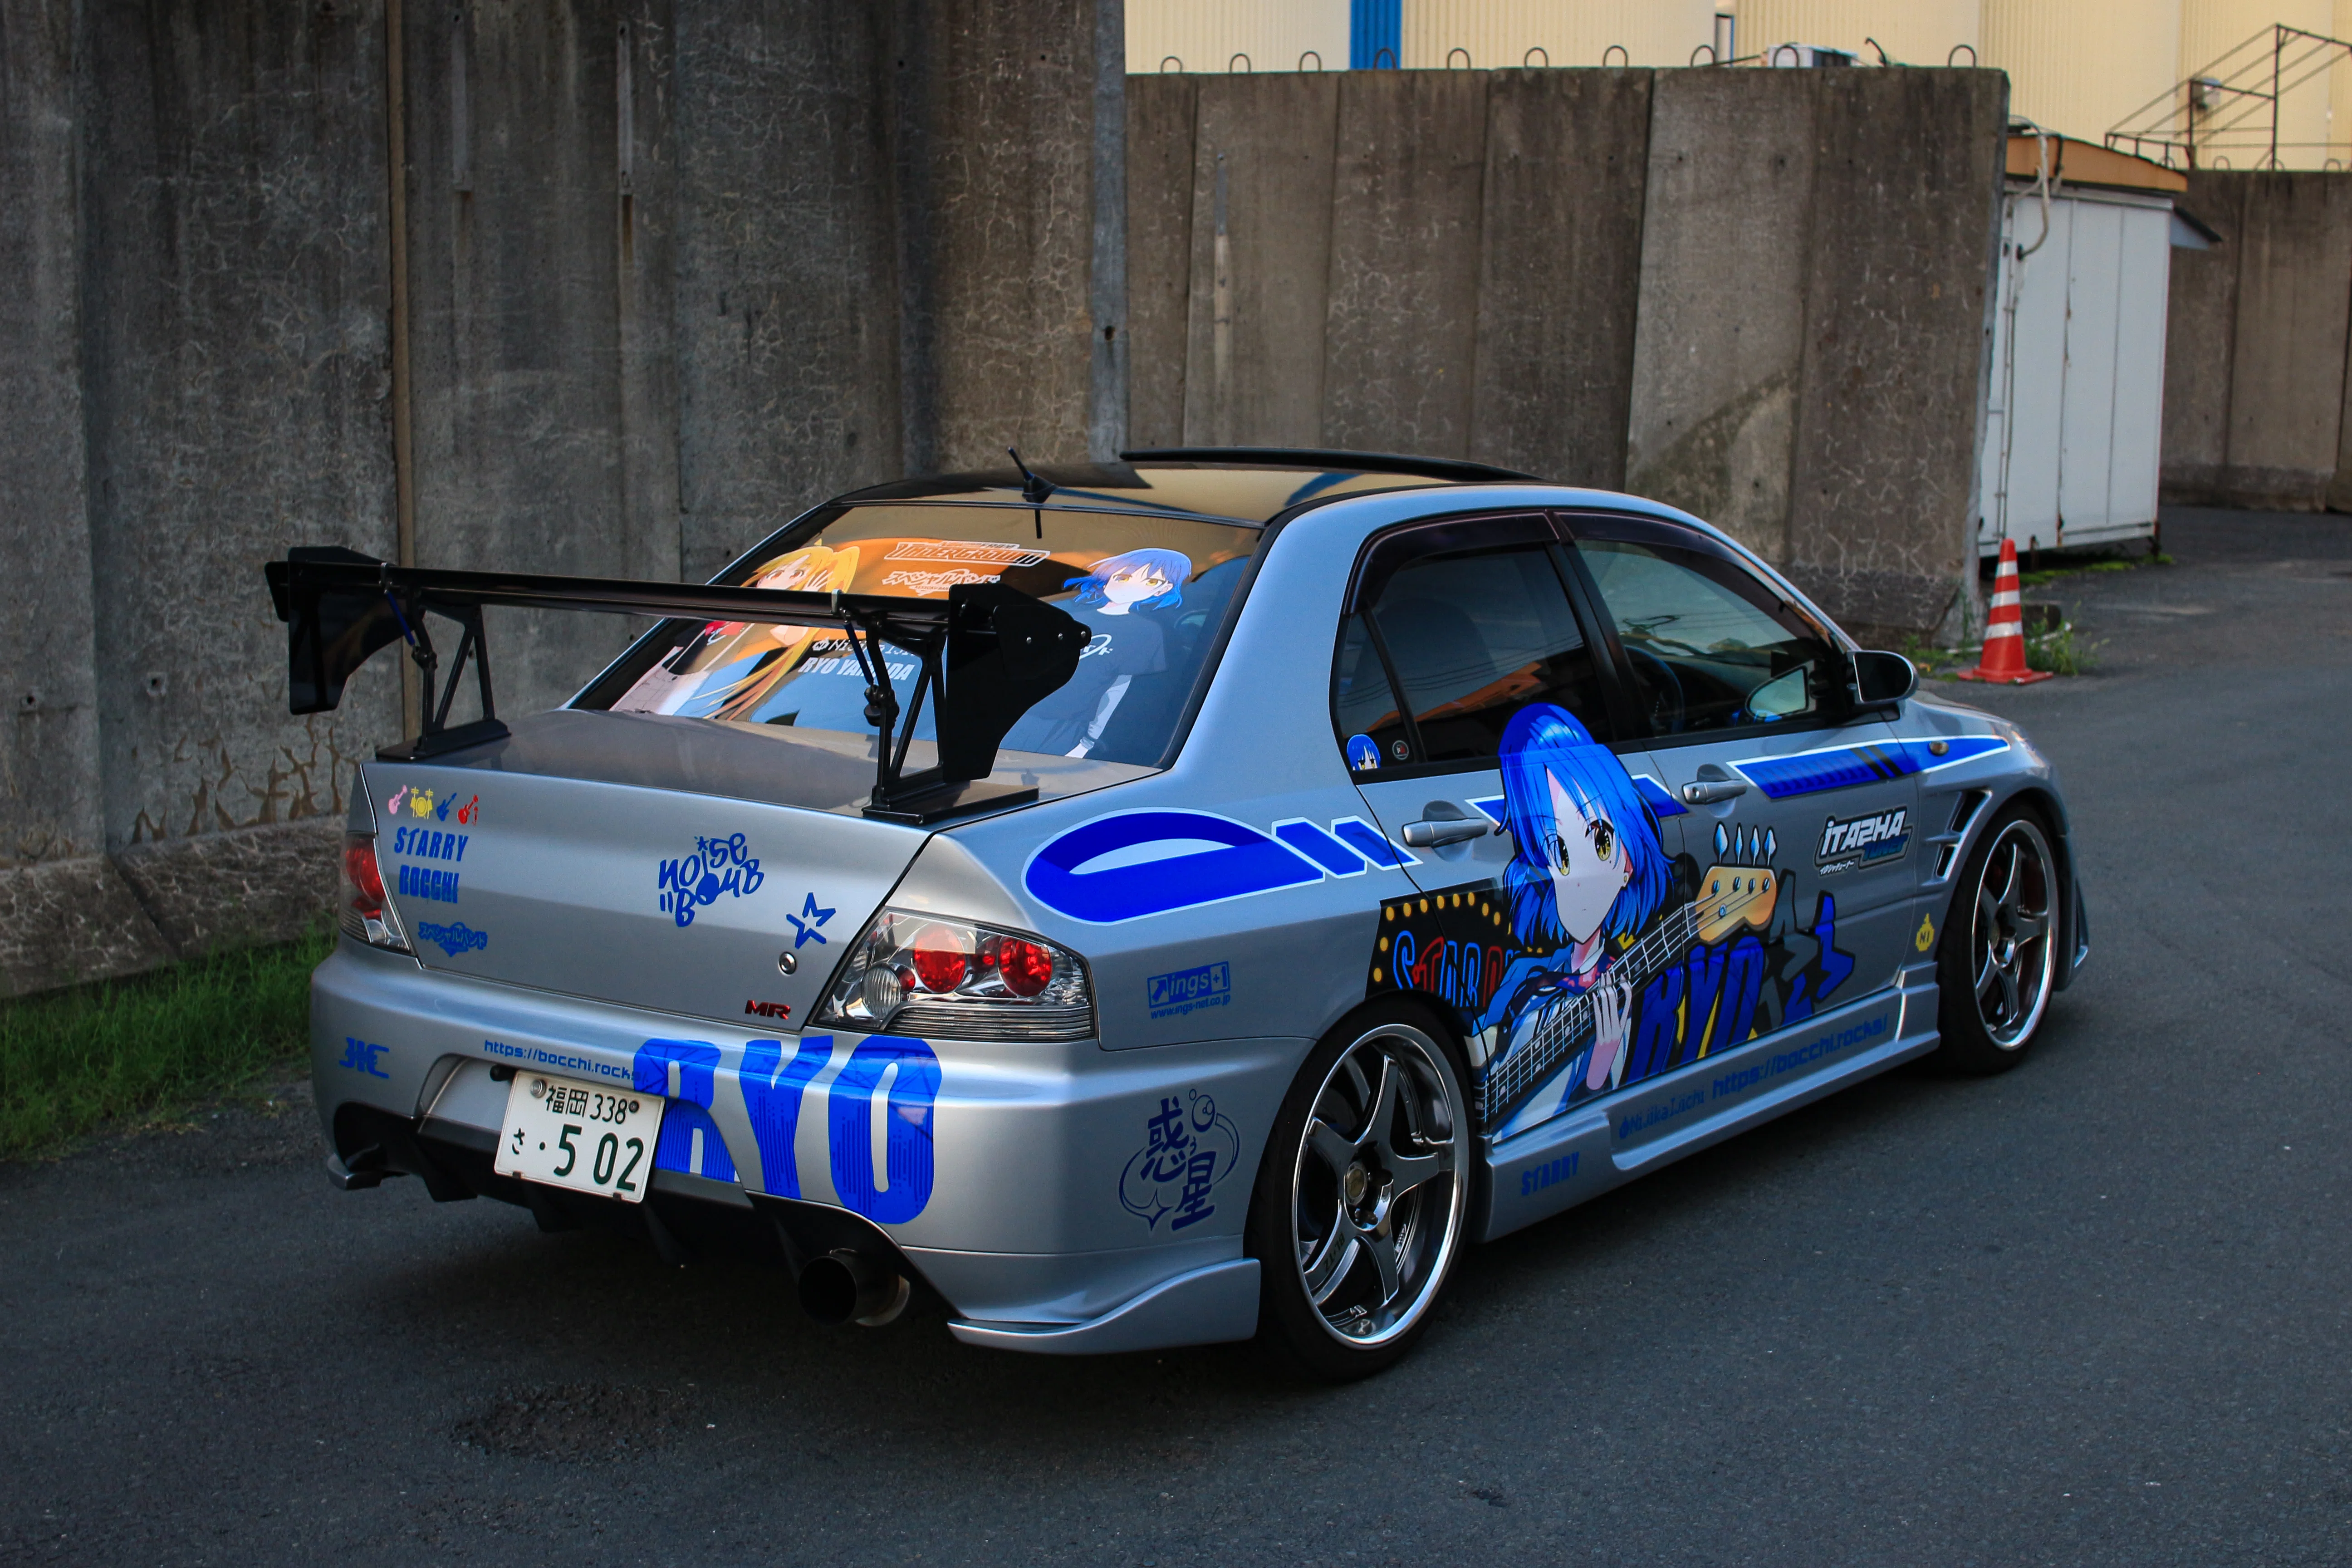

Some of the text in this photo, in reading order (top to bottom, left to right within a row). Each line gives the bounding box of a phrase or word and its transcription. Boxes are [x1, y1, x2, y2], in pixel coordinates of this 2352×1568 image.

[798, 657, 839, 674] RYO
[394, 826, 469, 862] STARRY
[745, 1000, 791, 1020] MR
[546, 1085, 628, 1124] 福岡 338
[512, 1127, 524, 1155] さ
